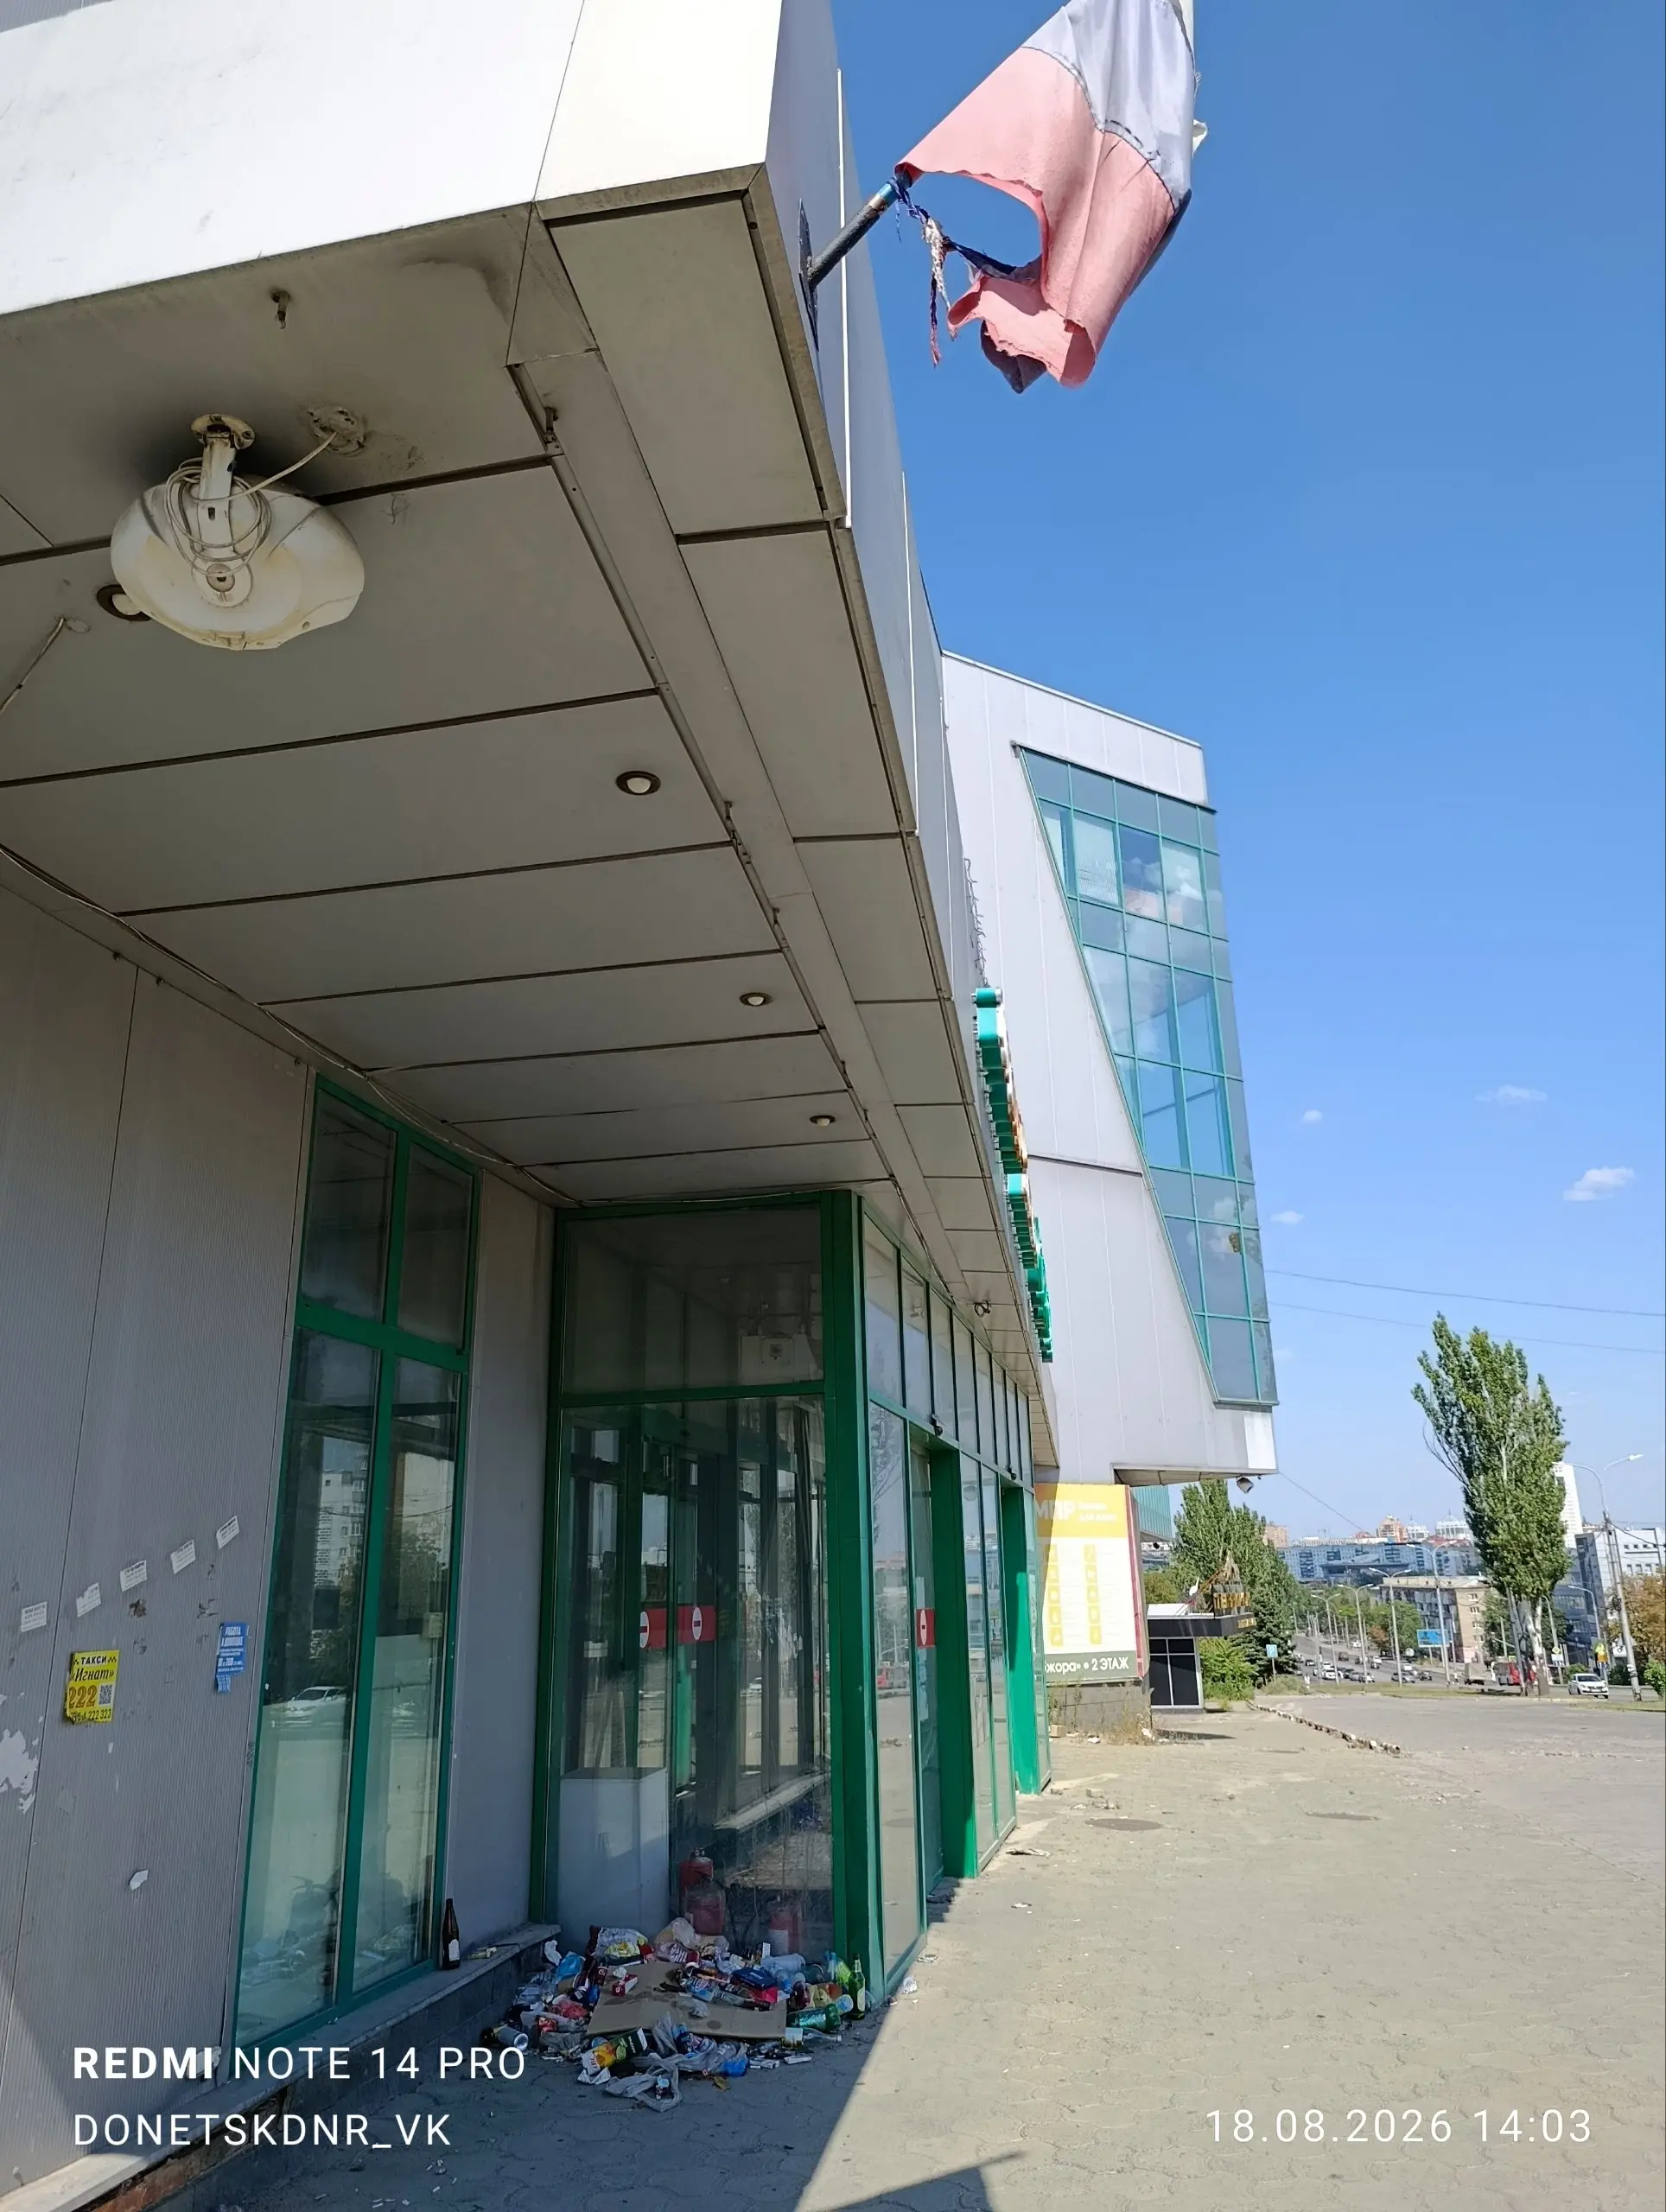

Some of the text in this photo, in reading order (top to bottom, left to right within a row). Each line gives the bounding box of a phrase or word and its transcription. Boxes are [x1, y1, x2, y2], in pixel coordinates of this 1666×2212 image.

[81, 1656, 107, 1665] ТАКСИ
[1091, 1658, 1098, 1671] 2
[1099, 1656, 1129, 1671] ЭТАЖ
[70, 1668, 115, 1682] «Игнат»
[68, 1685, 98, 1709] 222
